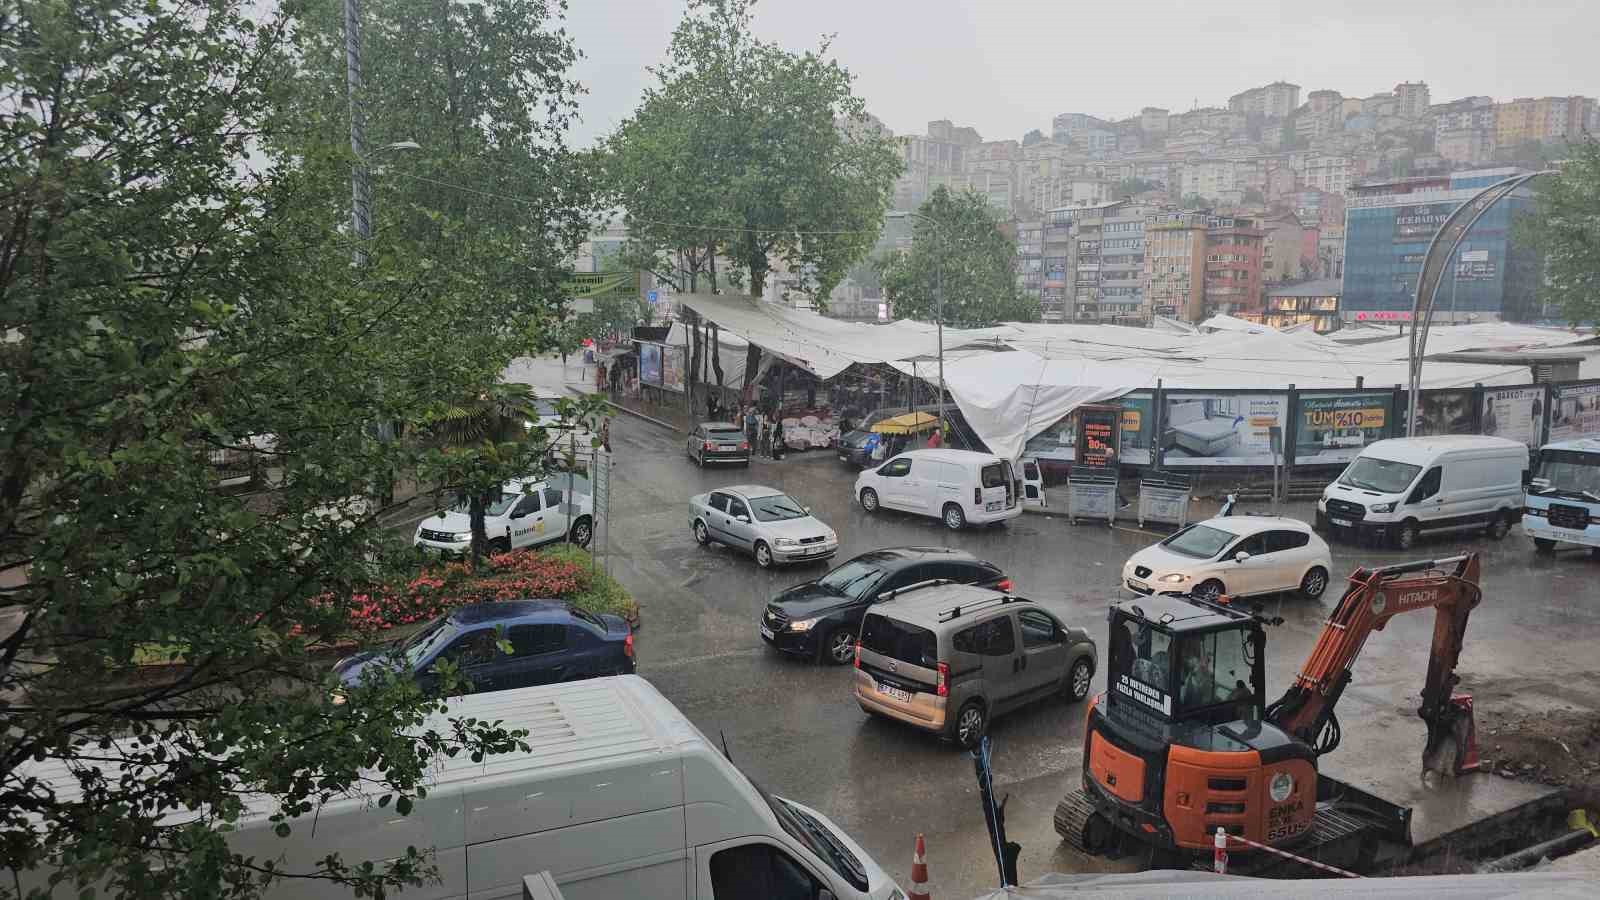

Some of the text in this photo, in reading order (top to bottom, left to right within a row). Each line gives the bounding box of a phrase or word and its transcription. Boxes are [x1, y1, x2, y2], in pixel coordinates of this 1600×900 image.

[1304, 409, 1334, 426] TÜM
[1335, 412, 1363, 426] %10
[1399, 590, 1439, 605] HITACHI
[1129, 678, 1160, 701] METREDEN
